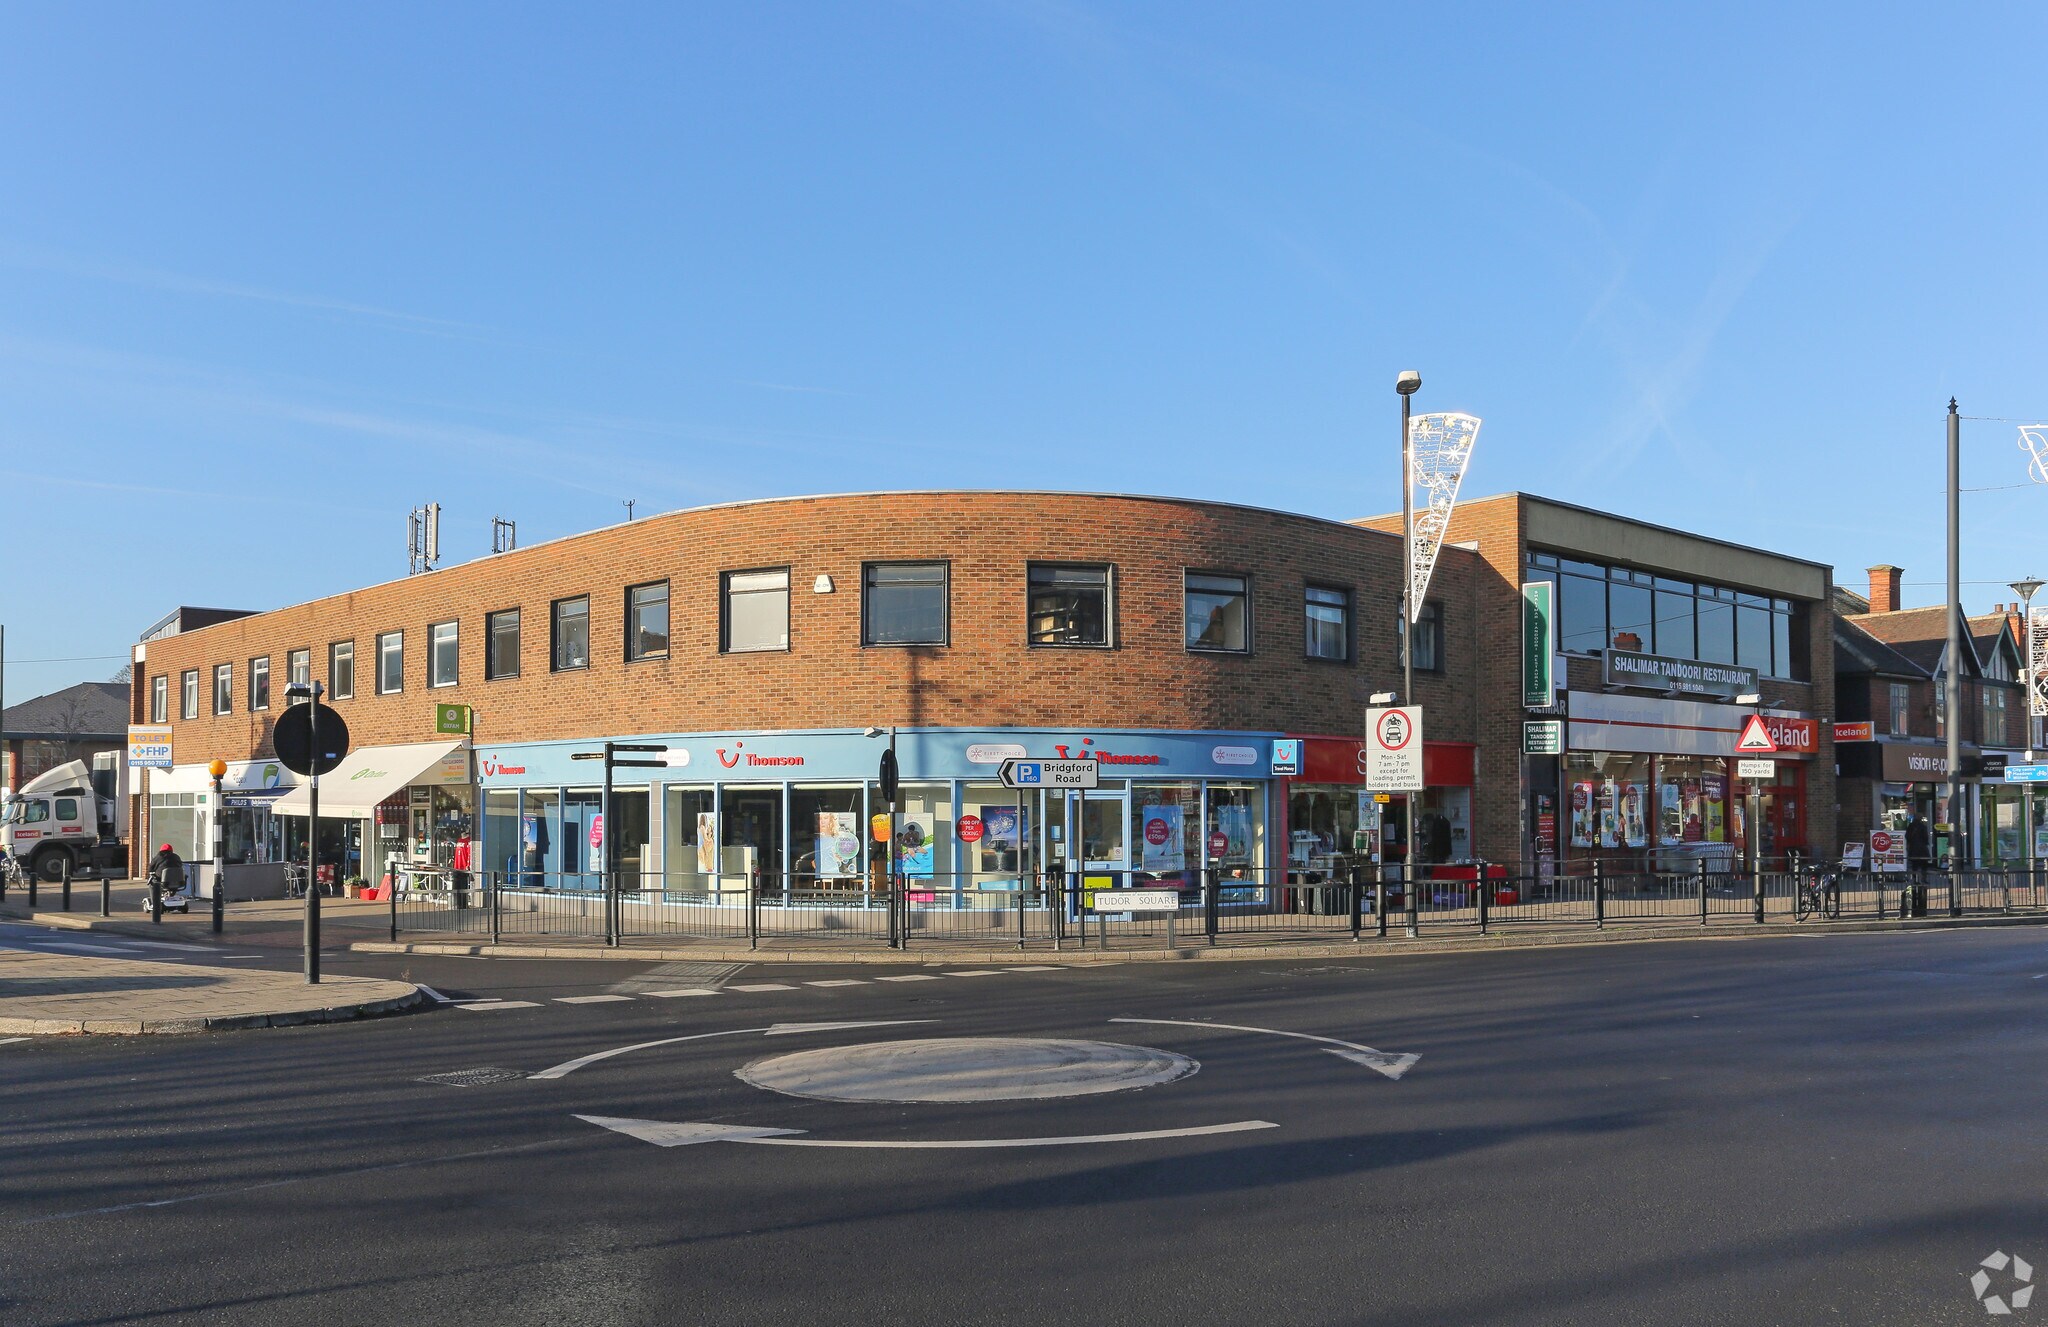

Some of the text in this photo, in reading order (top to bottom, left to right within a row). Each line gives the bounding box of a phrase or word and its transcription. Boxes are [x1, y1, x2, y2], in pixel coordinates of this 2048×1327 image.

[1614, 657, 1750, 685] SHALIMAR TANDOORI RESTAURANT
[1836, 728, 1867, 736] Iceland
[146, 747, 168, 756] FHP
[746, 754, 804, 766] Thomson
[1095, 751, 1159, 764] Thomson
[1908, 753, 1930, 770] vision
[1044, 764, 1092, 773] Bridgford
[1021, 766, 1032, 781] P
[1055, 775, 1081, 783] Road
[1873, 837, 1889, 845] 75p
[1140, 896, 1176, 905] SQUARE
